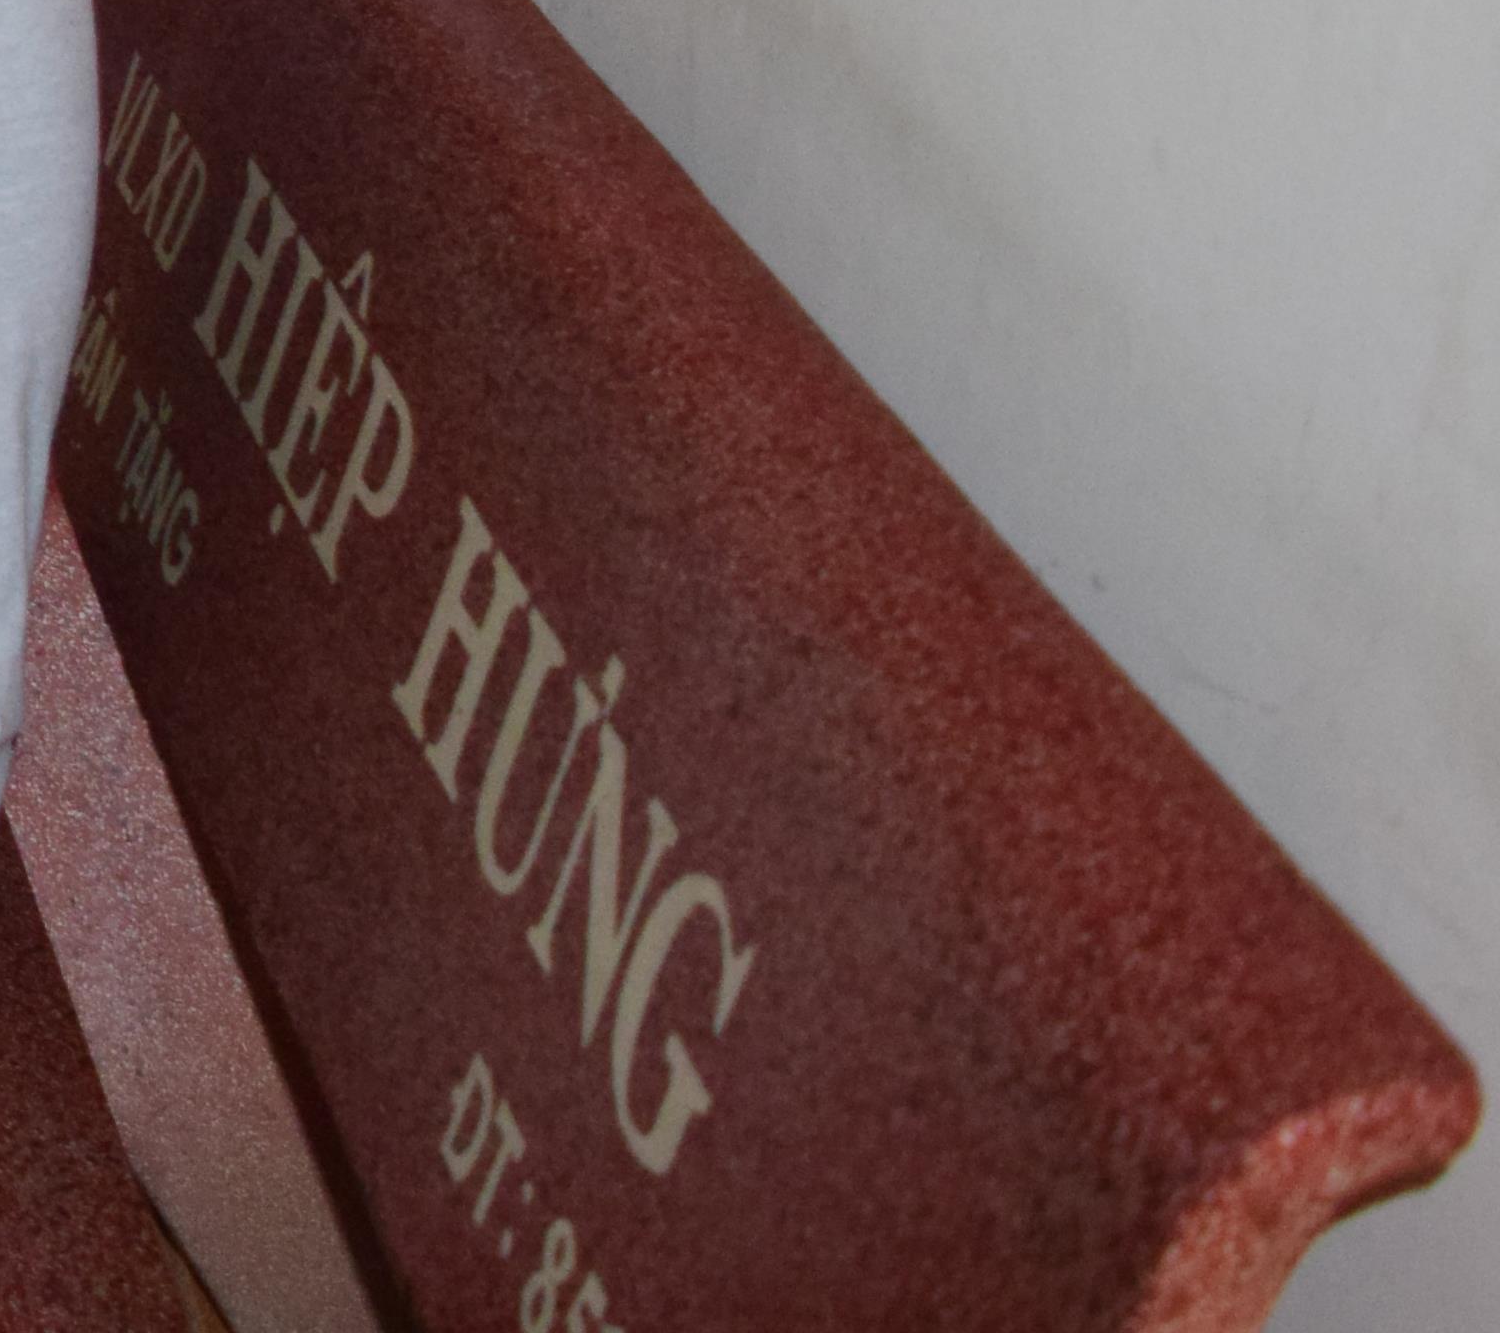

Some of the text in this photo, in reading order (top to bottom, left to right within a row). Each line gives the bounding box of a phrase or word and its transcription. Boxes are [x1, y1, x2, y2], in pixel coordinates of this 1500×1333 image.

[104, 50, 759, 1177] VLXD HIỆP HƯNG
[116, 388, 201, 587] TẶNG
